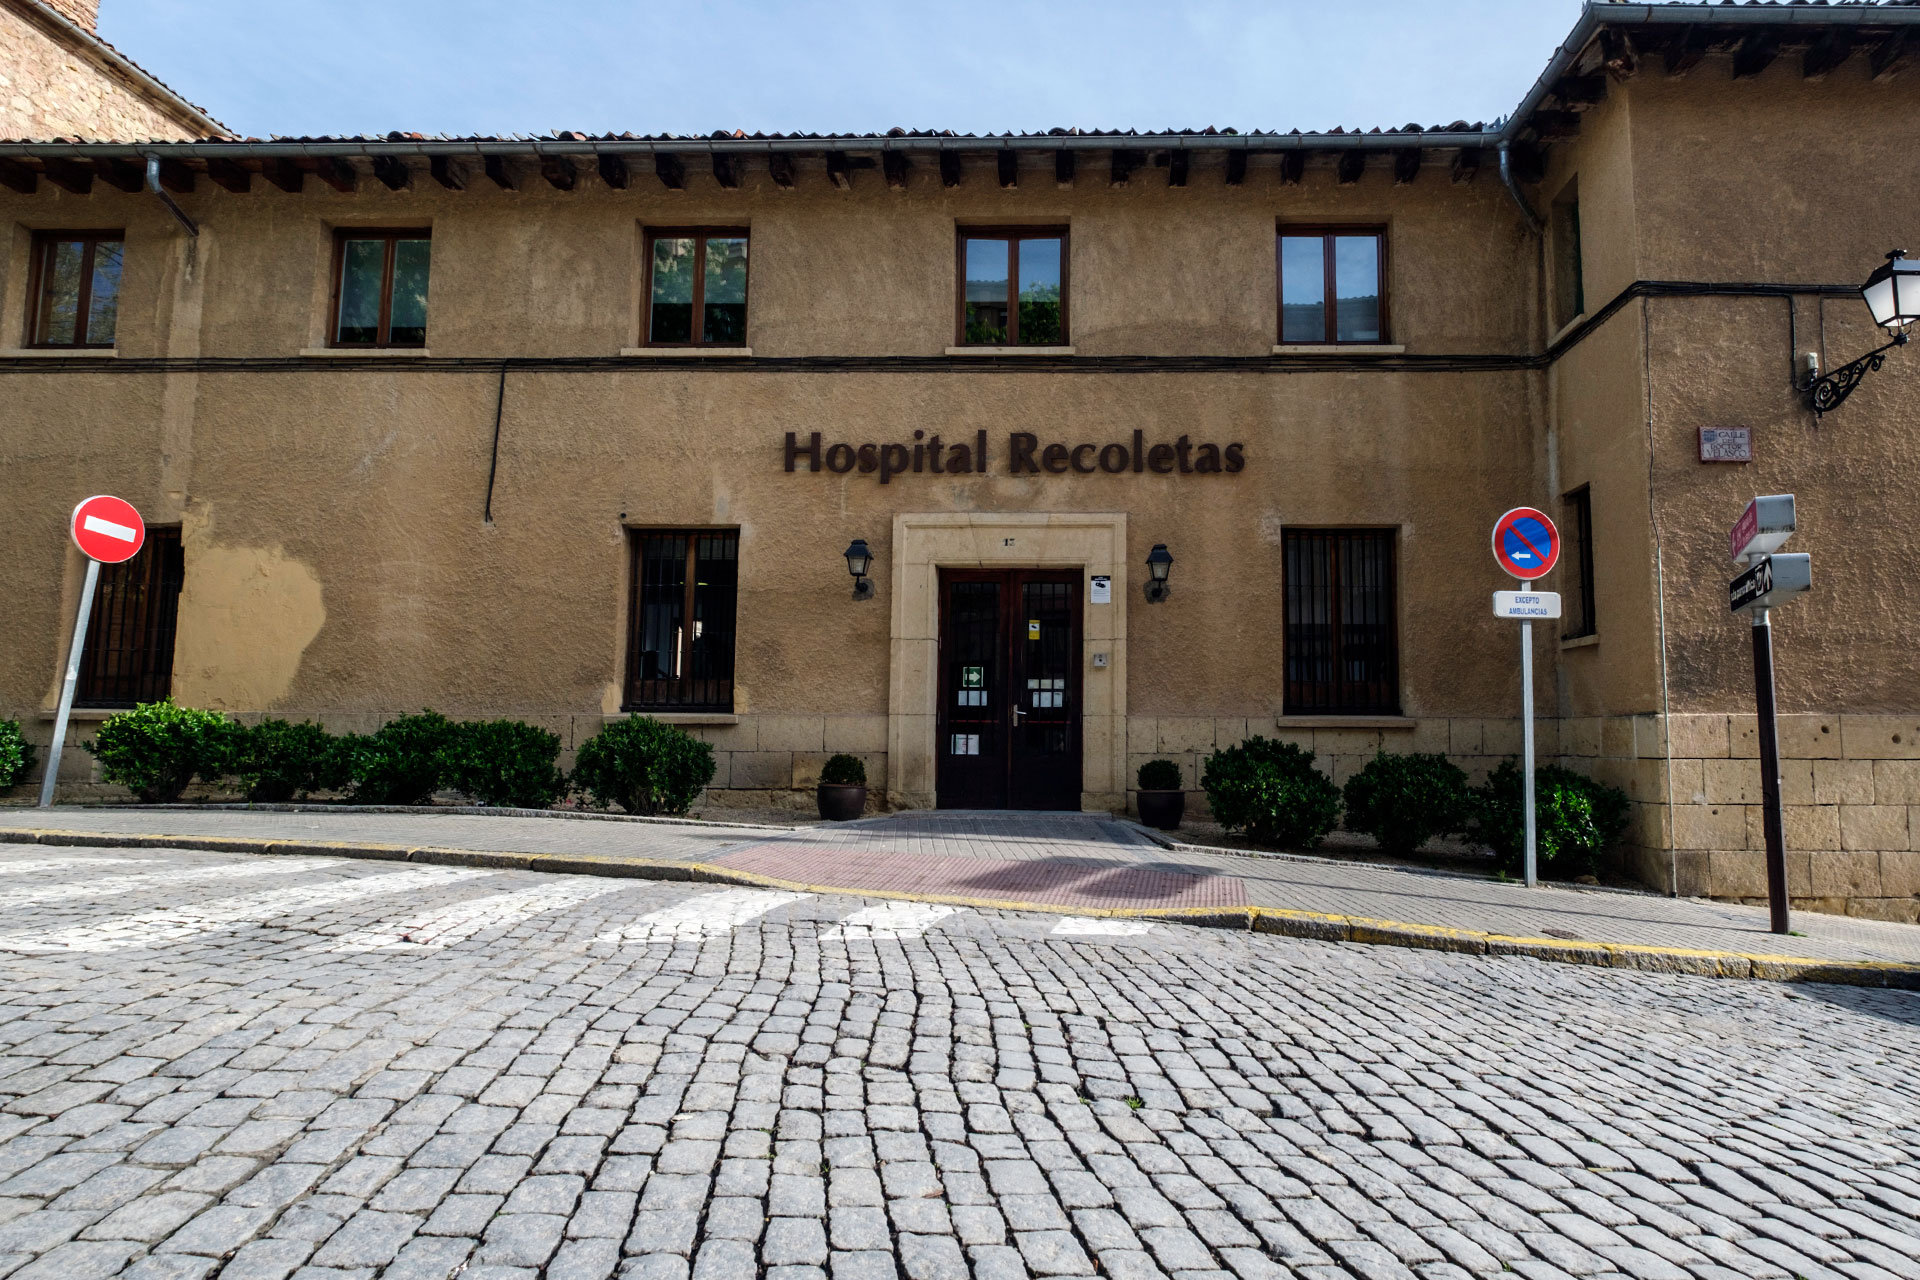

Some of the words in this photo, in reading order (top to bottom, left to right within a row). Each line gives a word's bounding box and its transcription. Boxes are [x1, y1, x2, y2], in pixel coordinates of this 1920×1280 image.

[784, 429, 988, 484] Hospital
[1009, 429, 1246, 474] Recoletas
[1706, 449, 1747, 457] VELASCO
[1515, 596, 1540, 604] EXCEPTO
[1509, 607, 1548, 616] AMBULANCIAS
